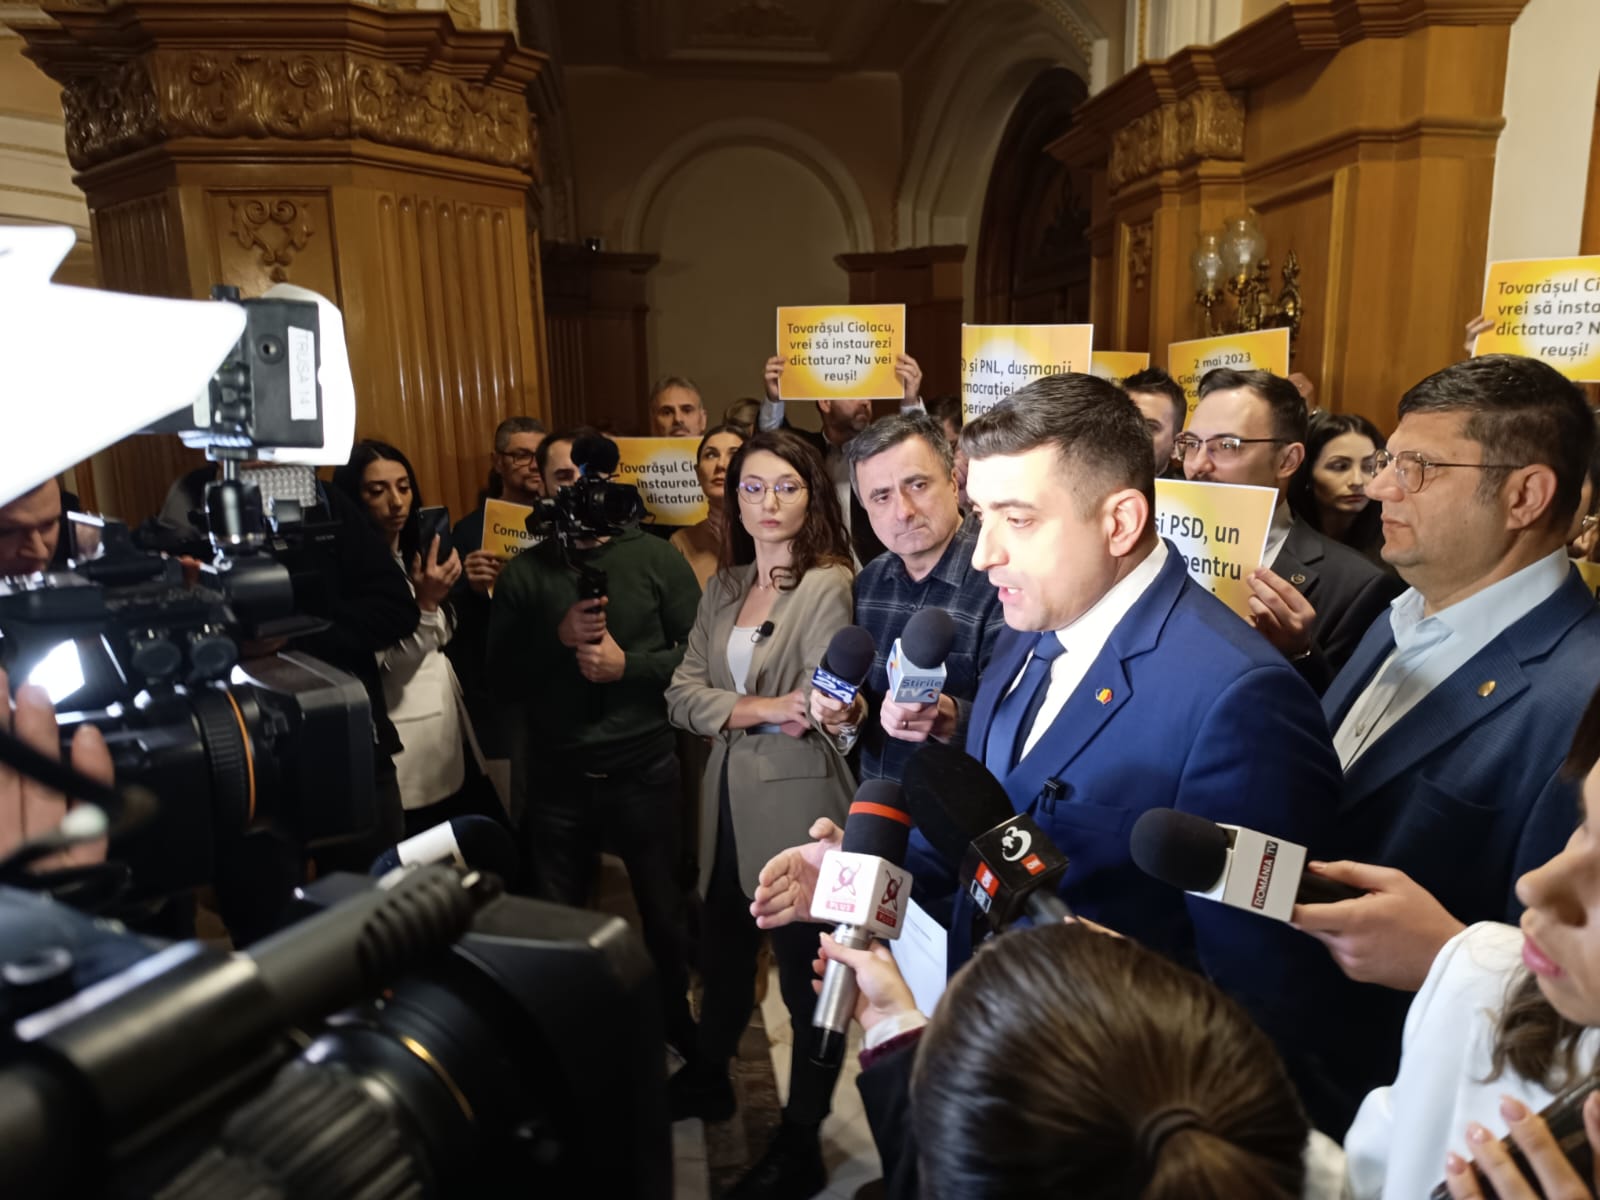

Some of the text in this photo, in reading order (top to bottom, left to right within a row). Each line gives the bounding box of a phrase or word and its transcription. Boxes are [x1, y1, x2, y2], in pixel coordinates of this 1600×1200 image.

[1498, 278, 1579, 298] Tovarășul
[1498, 301, 1528, 316] vrei
[1533, 301, 1552, 315] să
[787, 321, 895, 336] Tovarășul Ciolacu,
[1496, 322, 1583, 336] dictatura?
[789, 338, 892, 350] vrei să instaurezi
[1540, 342, 1589, 362] reuși!
[790, 354, 892, 366] dictatura? Nu vei
[1194, 352, 1252, 369] 2 mai 2023
[969, 358, 978, 377] și
[980, 359, 1004, 376] PNL,
[1008, 360, 1072, 380] dușmanii
[824, 371, 857, 385] reuși!
[620, 461, 678, 476] Tovarășul
[647, 493, 703, 504] dictatura
[1170, 514, 1208, 545] PSD,
[1215, 525, 1240, 545] un
[1266, 842, 1278, 855] TV
